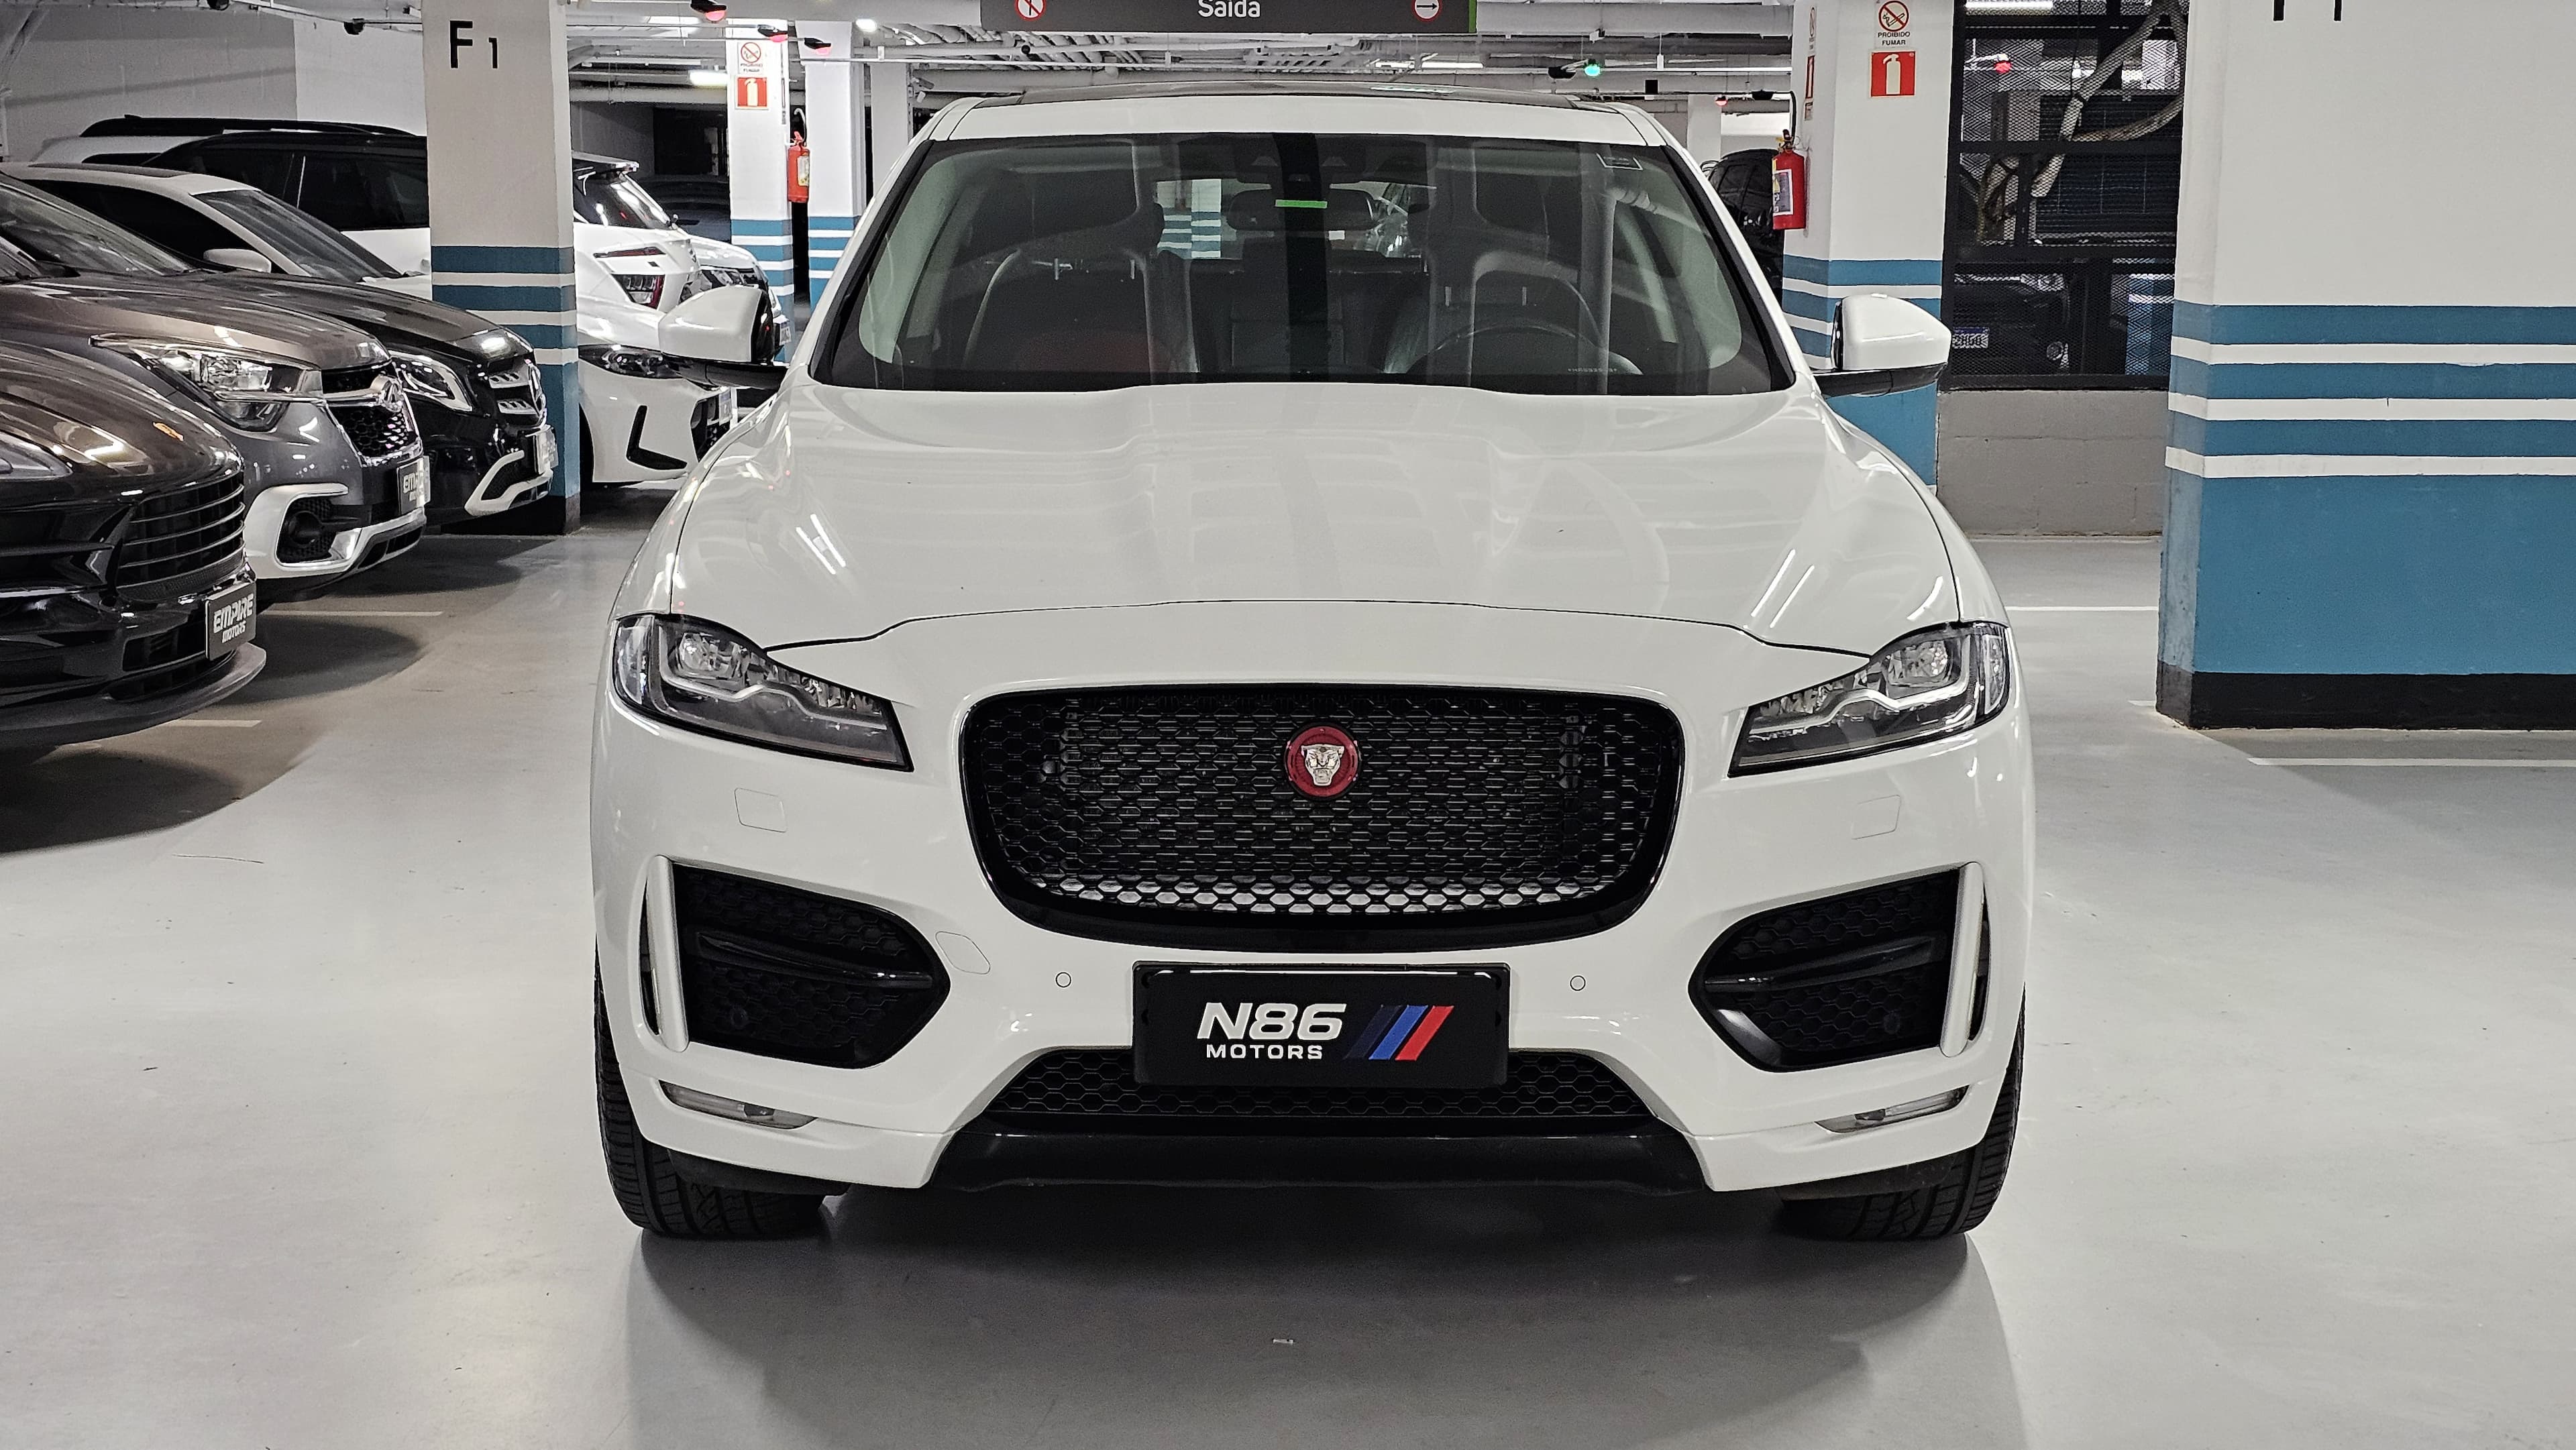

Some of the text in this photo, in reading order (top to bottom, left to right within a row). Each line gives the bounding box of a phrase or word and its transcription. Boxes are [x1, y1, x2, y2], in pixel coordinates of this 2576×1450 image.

[214, 593, 254, 634] EMPIRE
[222, 620, 247, 643] MOTORS
[1197, 1002, 1347, 1040] N86
[1206, 1044, 1323, 1060] MOTORS
